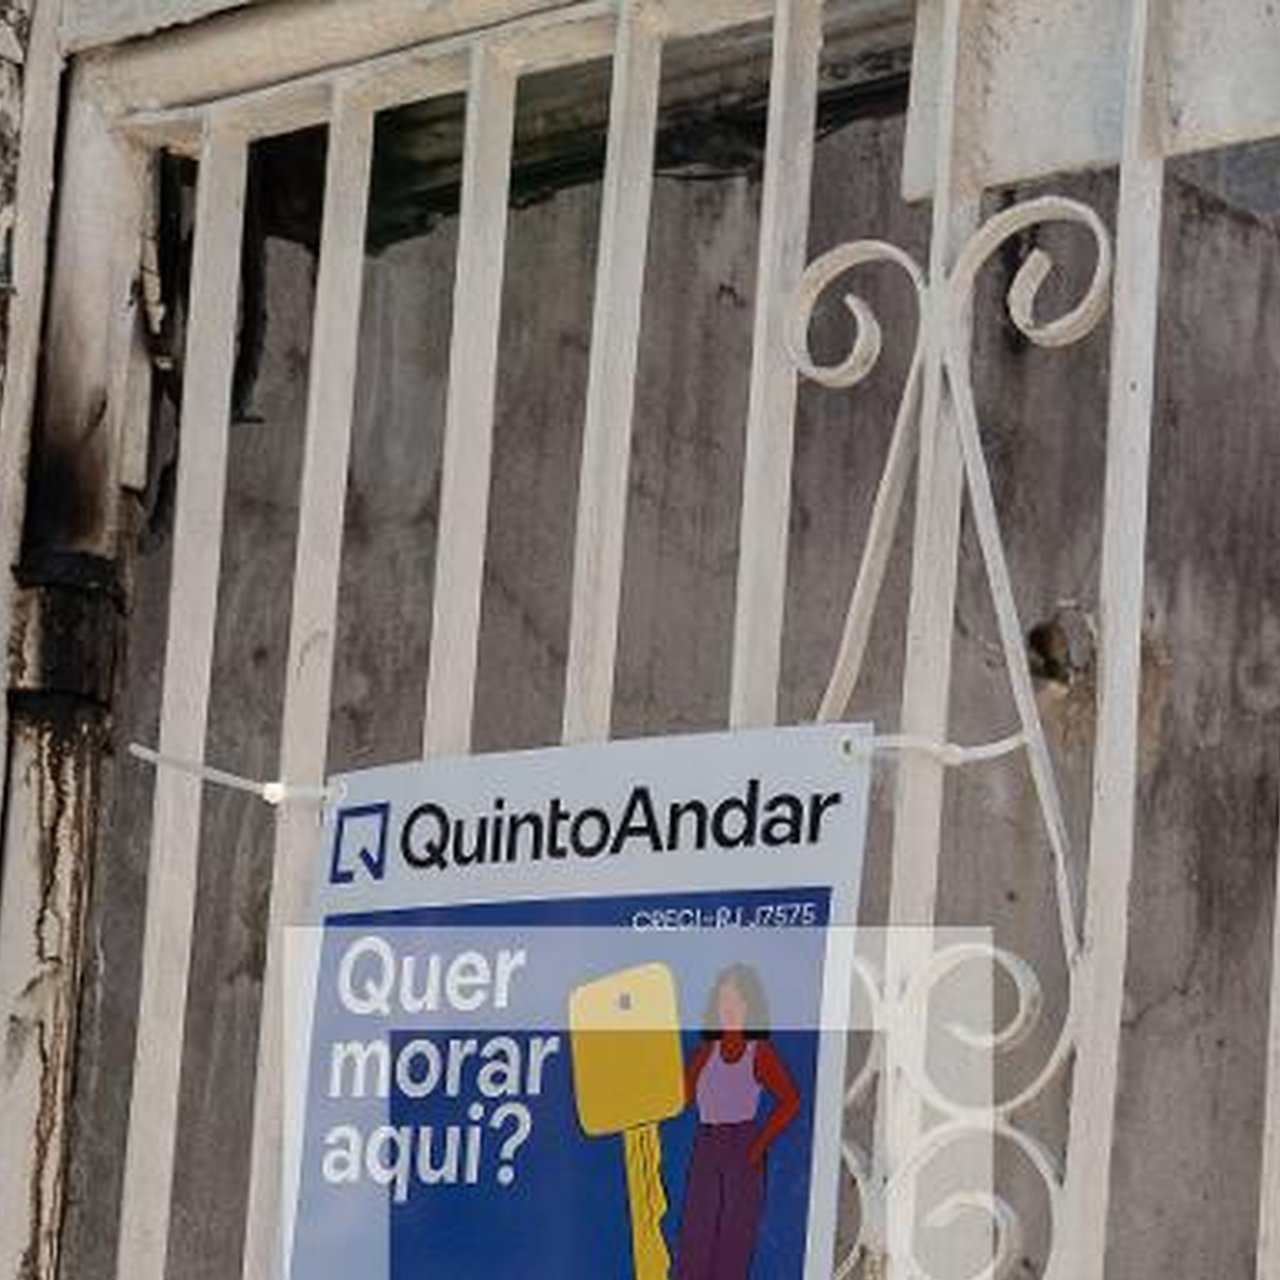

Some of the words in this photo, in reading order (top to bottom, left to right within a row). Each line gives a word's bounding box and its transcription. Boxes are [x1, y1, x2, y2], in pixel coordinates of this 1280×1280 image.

[400, 779, 843, 871] QuintoAndar
[336, 935, 526, 1016] Quer
[328, 1035, 560, 1098] morar
[320, 1102, 532, 1203] aqui?
